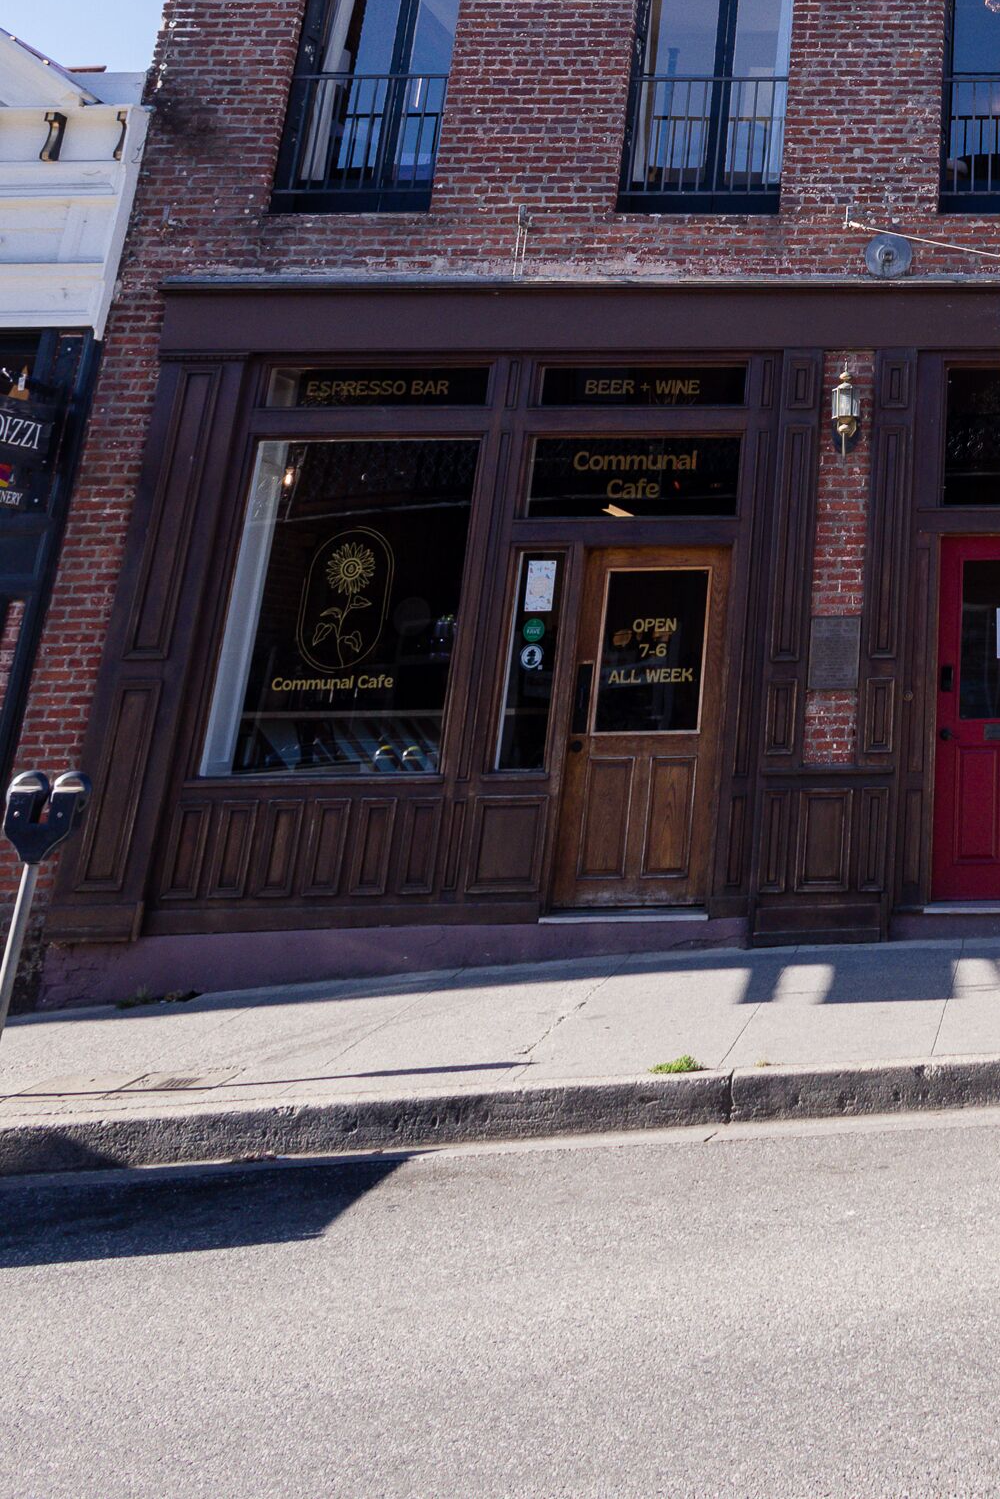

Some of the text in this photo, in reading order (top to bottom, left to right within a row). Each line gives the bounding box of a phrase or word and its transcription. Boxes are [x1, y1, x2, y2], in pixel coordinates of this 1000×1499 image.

[306, 380, 449, 396] ESPRESSO BAR
[585, 379, 700, 394] BEER + WINE
[573, 451, 698, 471] Communal
[606, 478, 660, 499] Cafe
[633, 618, 677, 633] OPEN
[640, 643, 667, 657] 7-6
[272, 674, 394, 690] Communal Cafe
[608, 668, 693, 684] ALL WEEK
